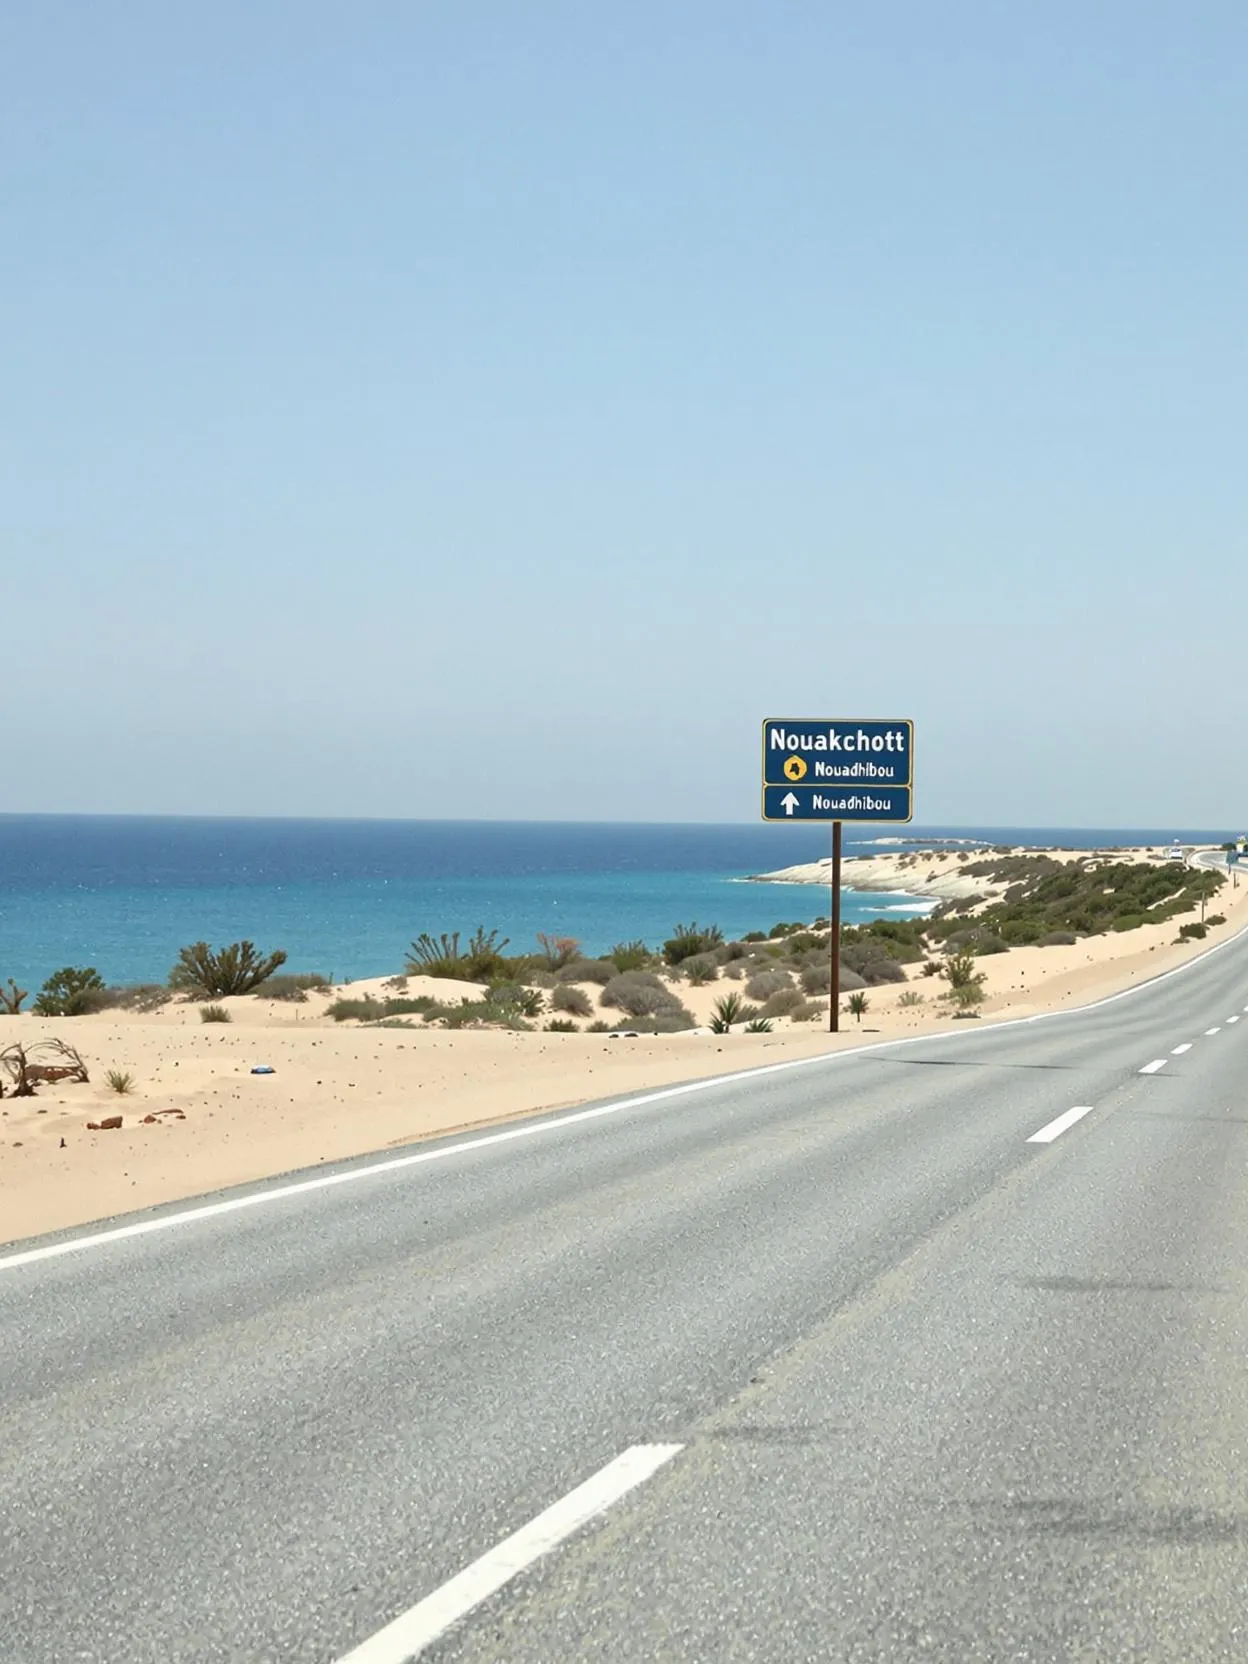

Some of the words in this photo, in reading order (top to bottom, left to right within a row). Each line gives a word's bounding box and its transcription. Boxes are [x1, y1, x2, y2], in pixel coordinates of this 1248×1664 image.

[771, 728, 904, 751] Nouakchott
[815, 761, 894, 777] Nouadhibou
[812, 794, 891, 810] Nouadhibou
